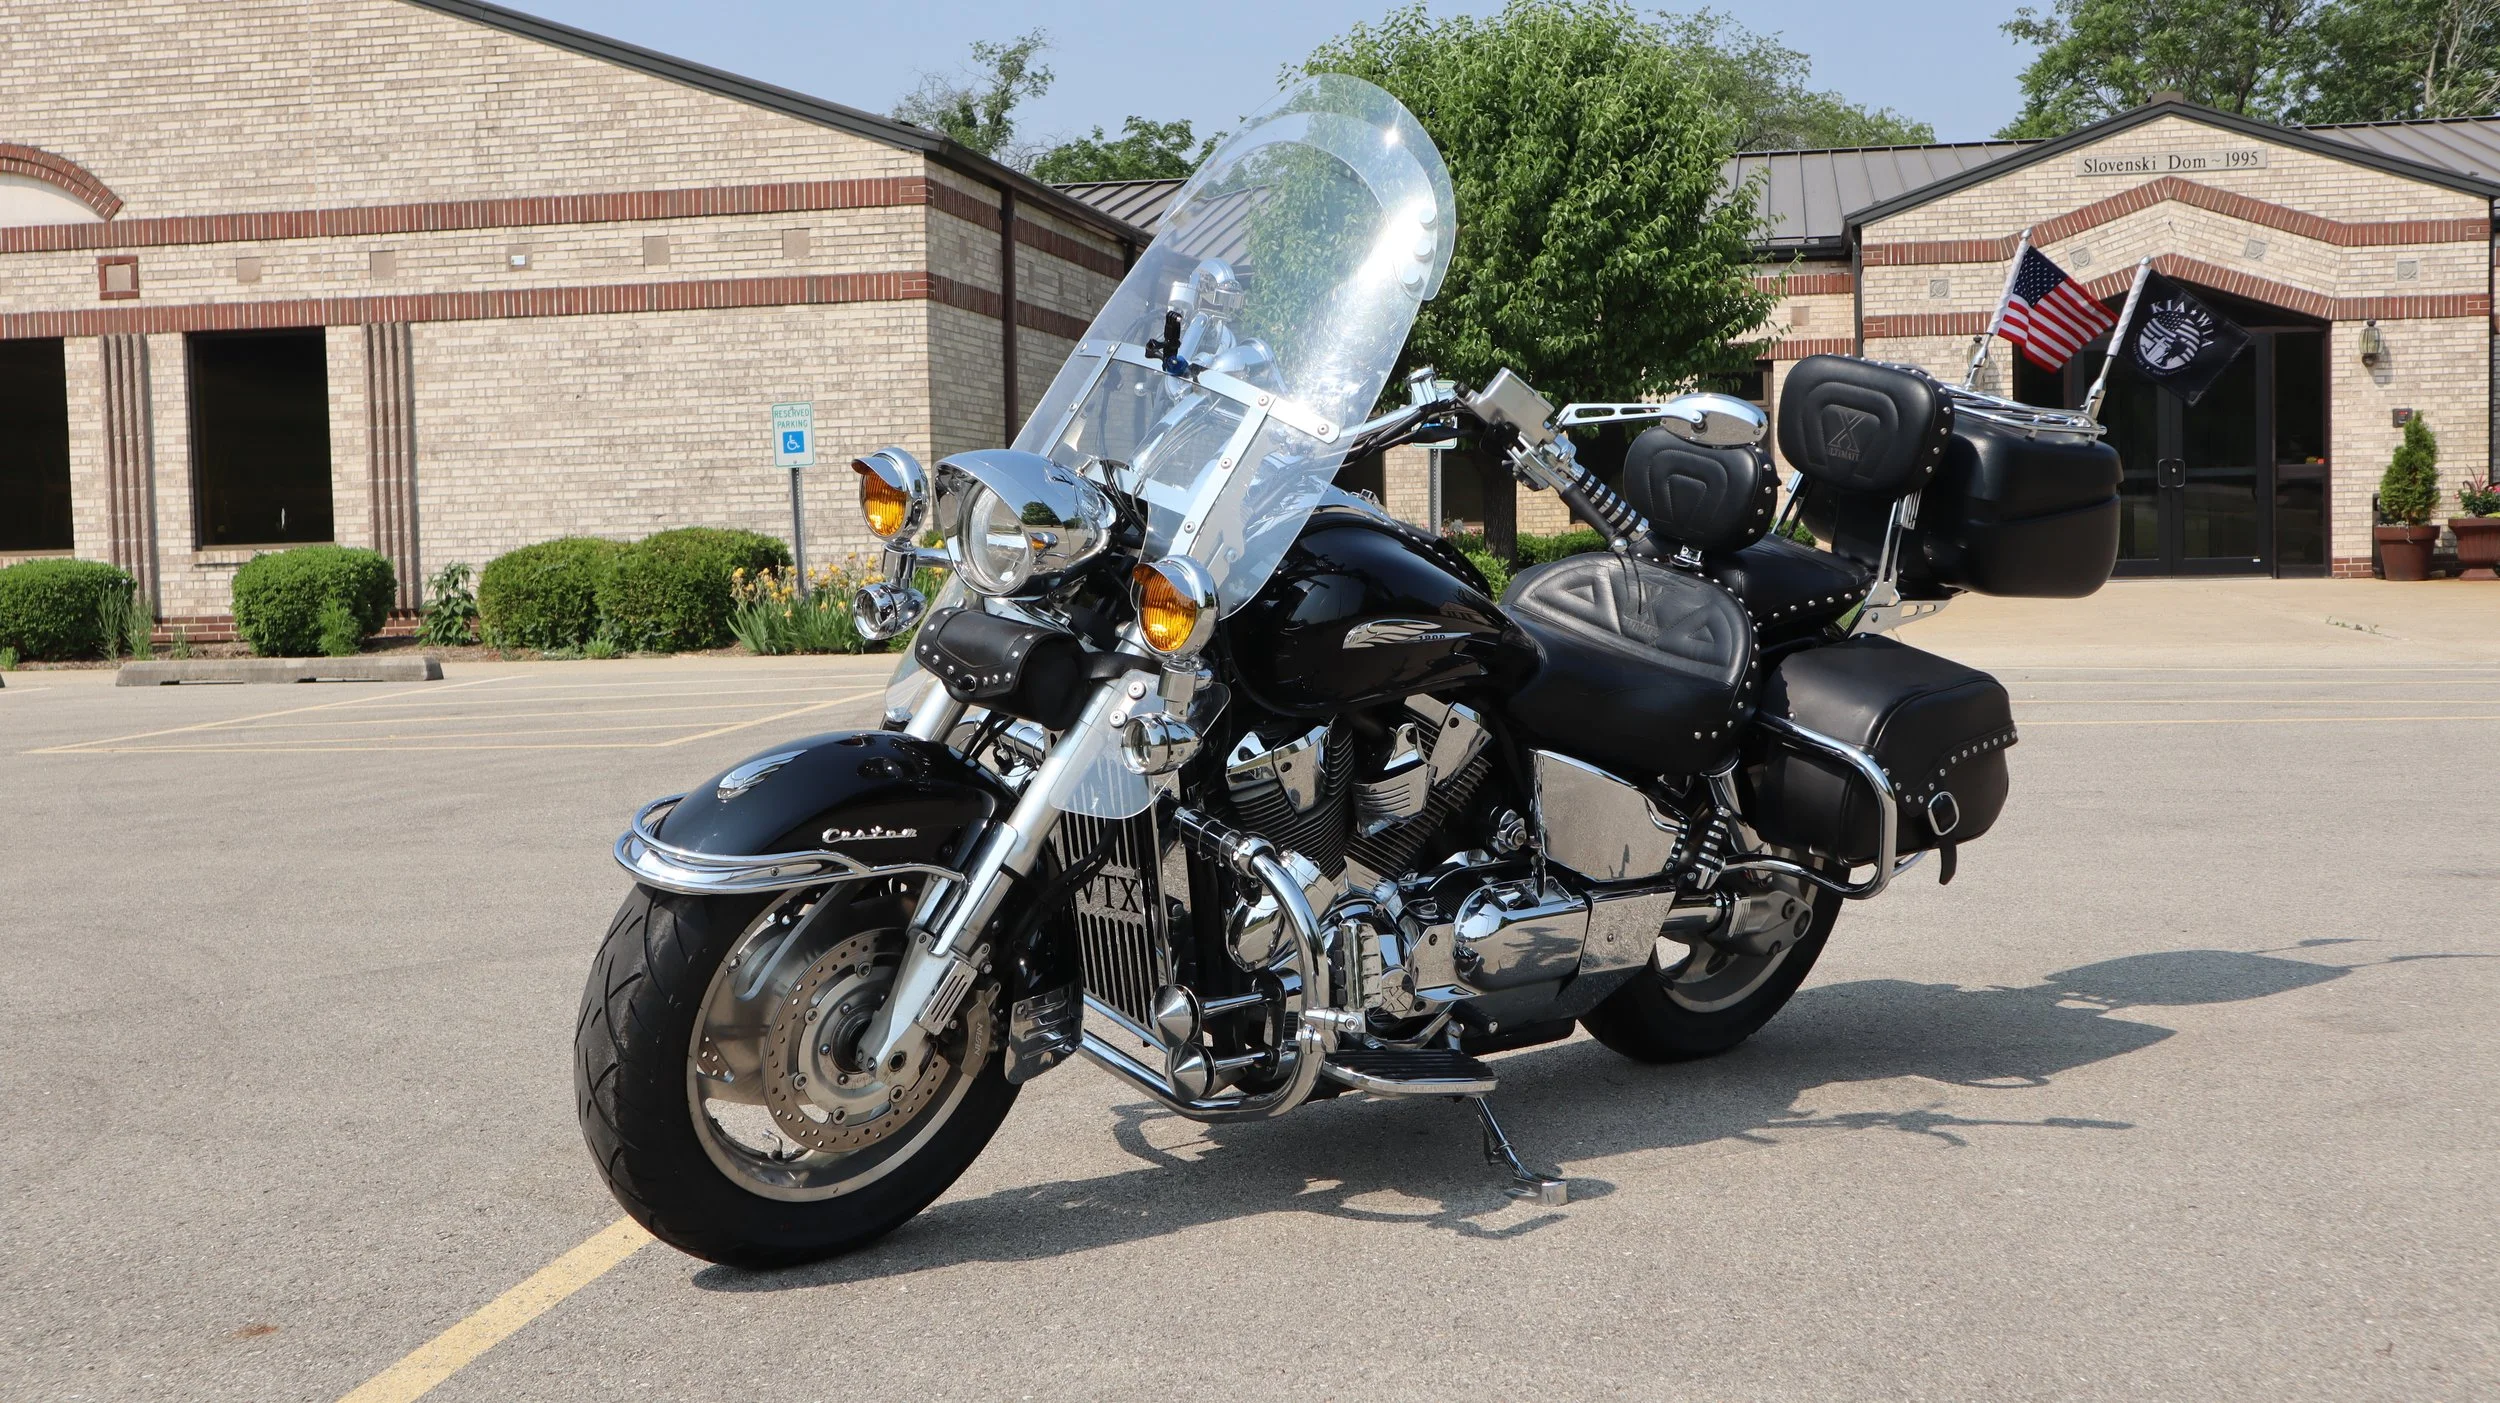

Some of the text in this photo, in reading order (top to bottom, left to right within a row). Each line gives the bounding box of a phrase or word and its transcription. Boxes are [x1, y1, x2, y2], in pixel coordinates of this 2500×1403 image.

[2083, 155, 2157, 173] Slovenski
[2168, 153, 2207, 170] Dom
[2226, 150, 2259, 168] 1995
[2150, 299, 2215, 348] KIA WIA
[773, 408, 810, 419] RESERVED
[776, 419, 808, 429] PARKING
[821, 825, 918, 844] Custom
[1080, 873, 1142, 915] VTX
